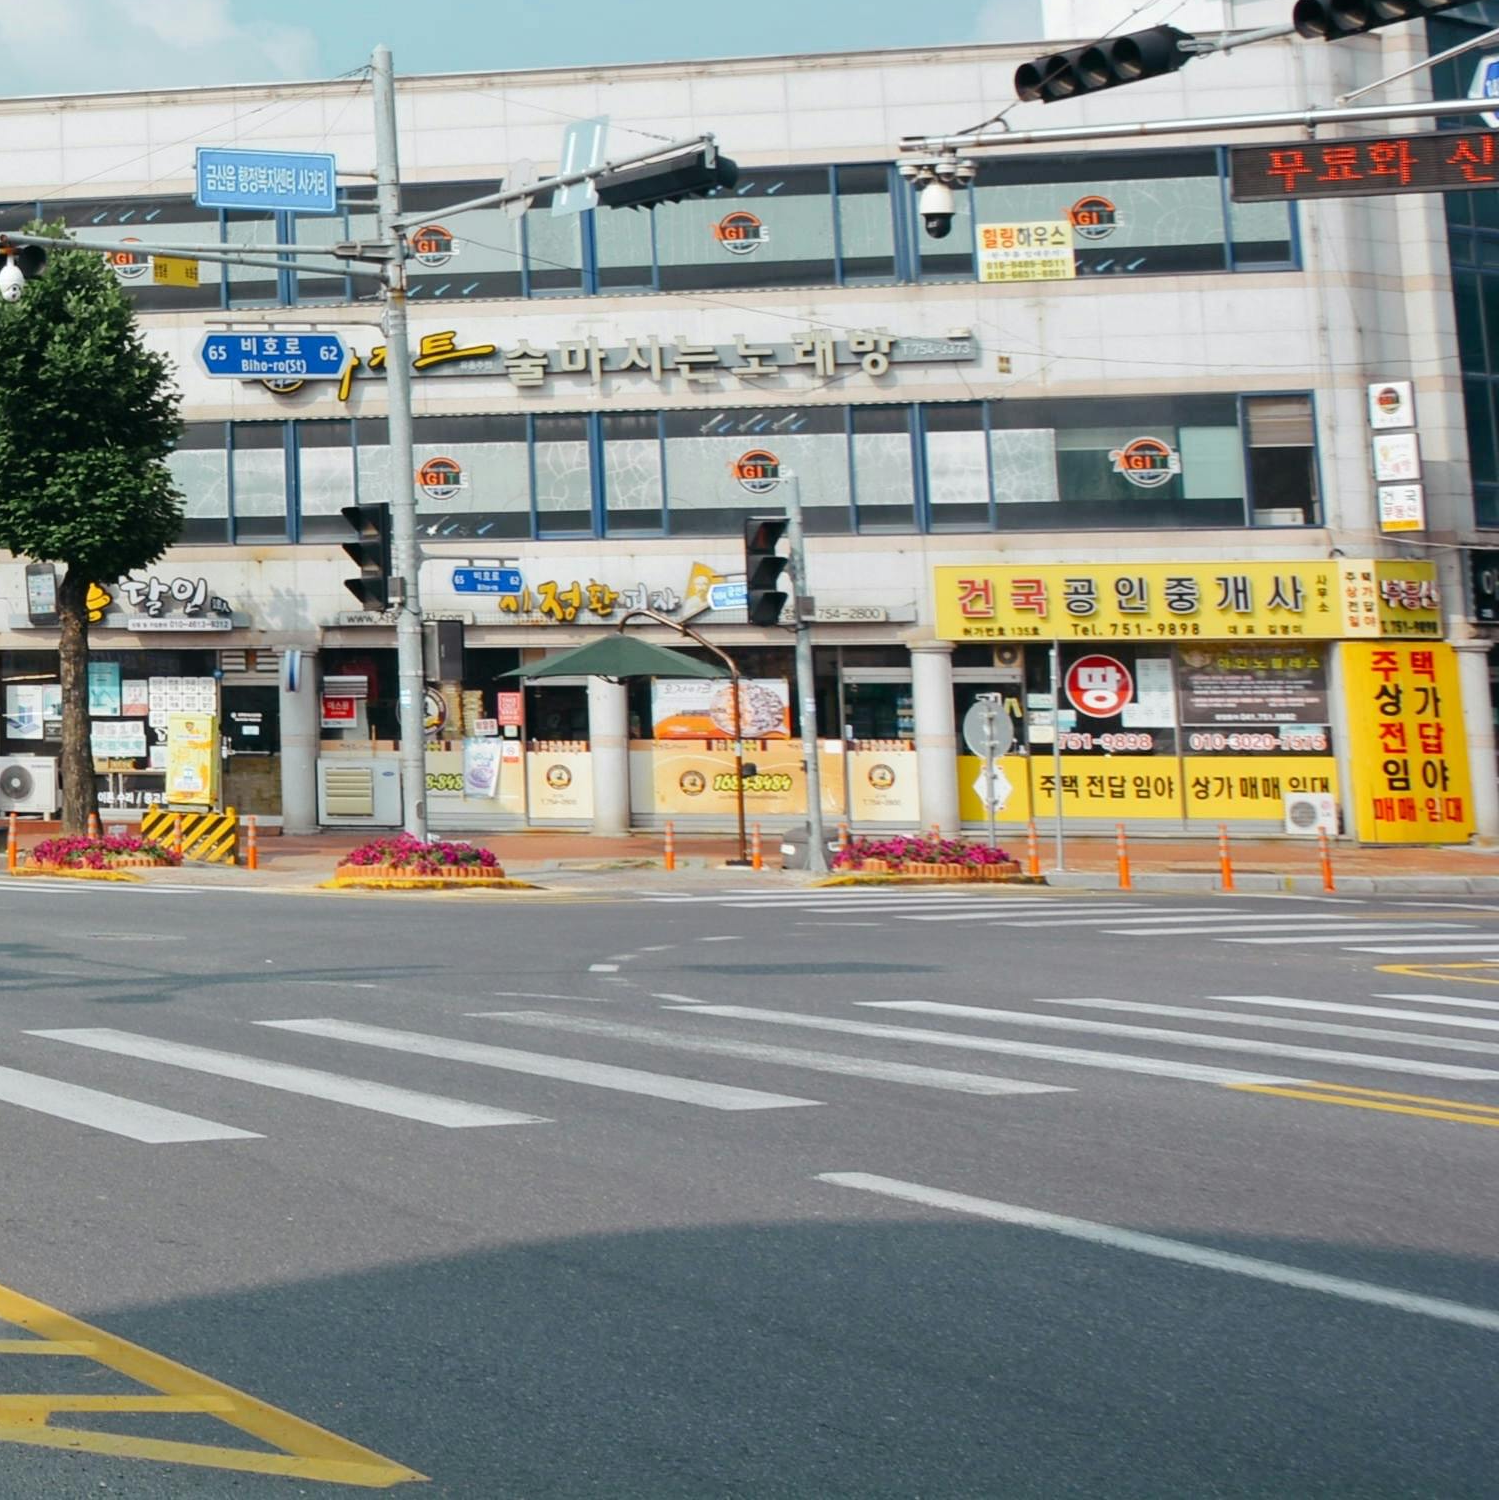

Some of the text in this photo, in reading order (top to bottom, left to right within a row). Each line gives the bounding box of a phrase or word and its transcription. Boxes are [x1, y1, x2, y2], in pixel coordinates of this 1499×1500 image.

[1266, 140, 1419, 193] 무료화
[205, 163, 329, 197] 금산읍 행정복지센터 사거리
[982, 226, 1065, 250] 힐링하우스
[207, 345, 227, 362] 65
[240, 336, 302, 357] 비호로
[319, 345, 339, 361] 62
[240, 358, 307, 375] Biho-ro(St)
[454, 575, 465, 585] 65
[509, 575, 520, 585] 62
[119, 576, 208, 616] 달인
[622, 582, 681, 612] 피자
[818, 607, 880, 620] 754-2800
[1072, 623, 1200, 636] Tel. 751-9898
[1370, 650, 1436, 683] 주택
[1077, 665, 1122, 710] 땅
[1374, 683, 1441, 718] 상가
[1378, 721, 1444, 755] 전답
[1040, 775, 1174, 799] 주택 전답 임야
[1382, 758, 1450, 792] 임야
[1191, 776, 1233, 800] 상가
[1240, 775, 1281, 800] 매매
